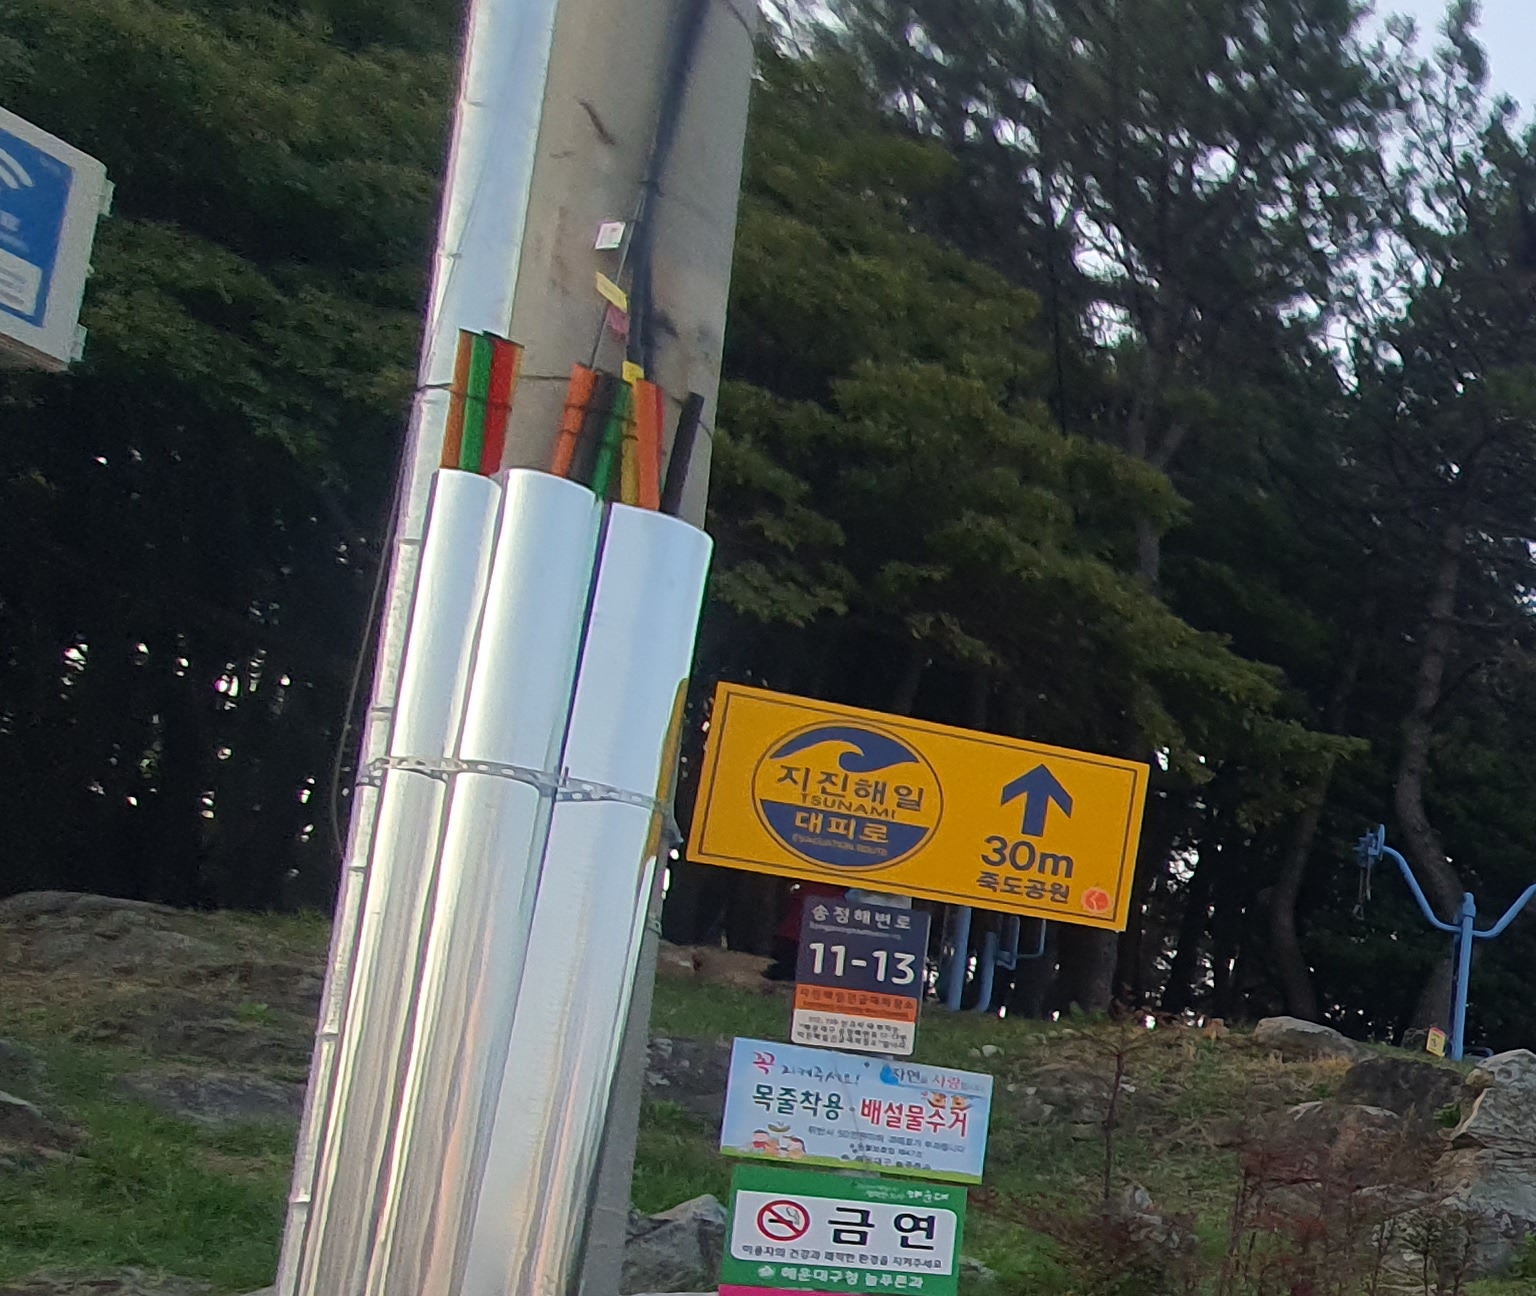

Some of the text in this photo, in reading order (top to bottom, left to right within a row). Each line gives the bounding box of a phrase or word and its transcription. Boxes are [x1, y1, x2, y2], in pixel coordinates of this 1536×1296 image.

[777, 765, 925, 812] 지진해일
[800, 793, 897, 820] TSUNAMI
[794, 811, 889, 843] 대피로
[981, 835, 1075, 879] 30m
[976, 871, 1070, 905] 죽도공원
[811, 904, 912, 930] 송정해변로
[809, 942, 917, 986] 11-13
[752, 1051, 776, 1075] 꼭
[752, 1083, 969, 1138] 목줄착용 배설물수거
